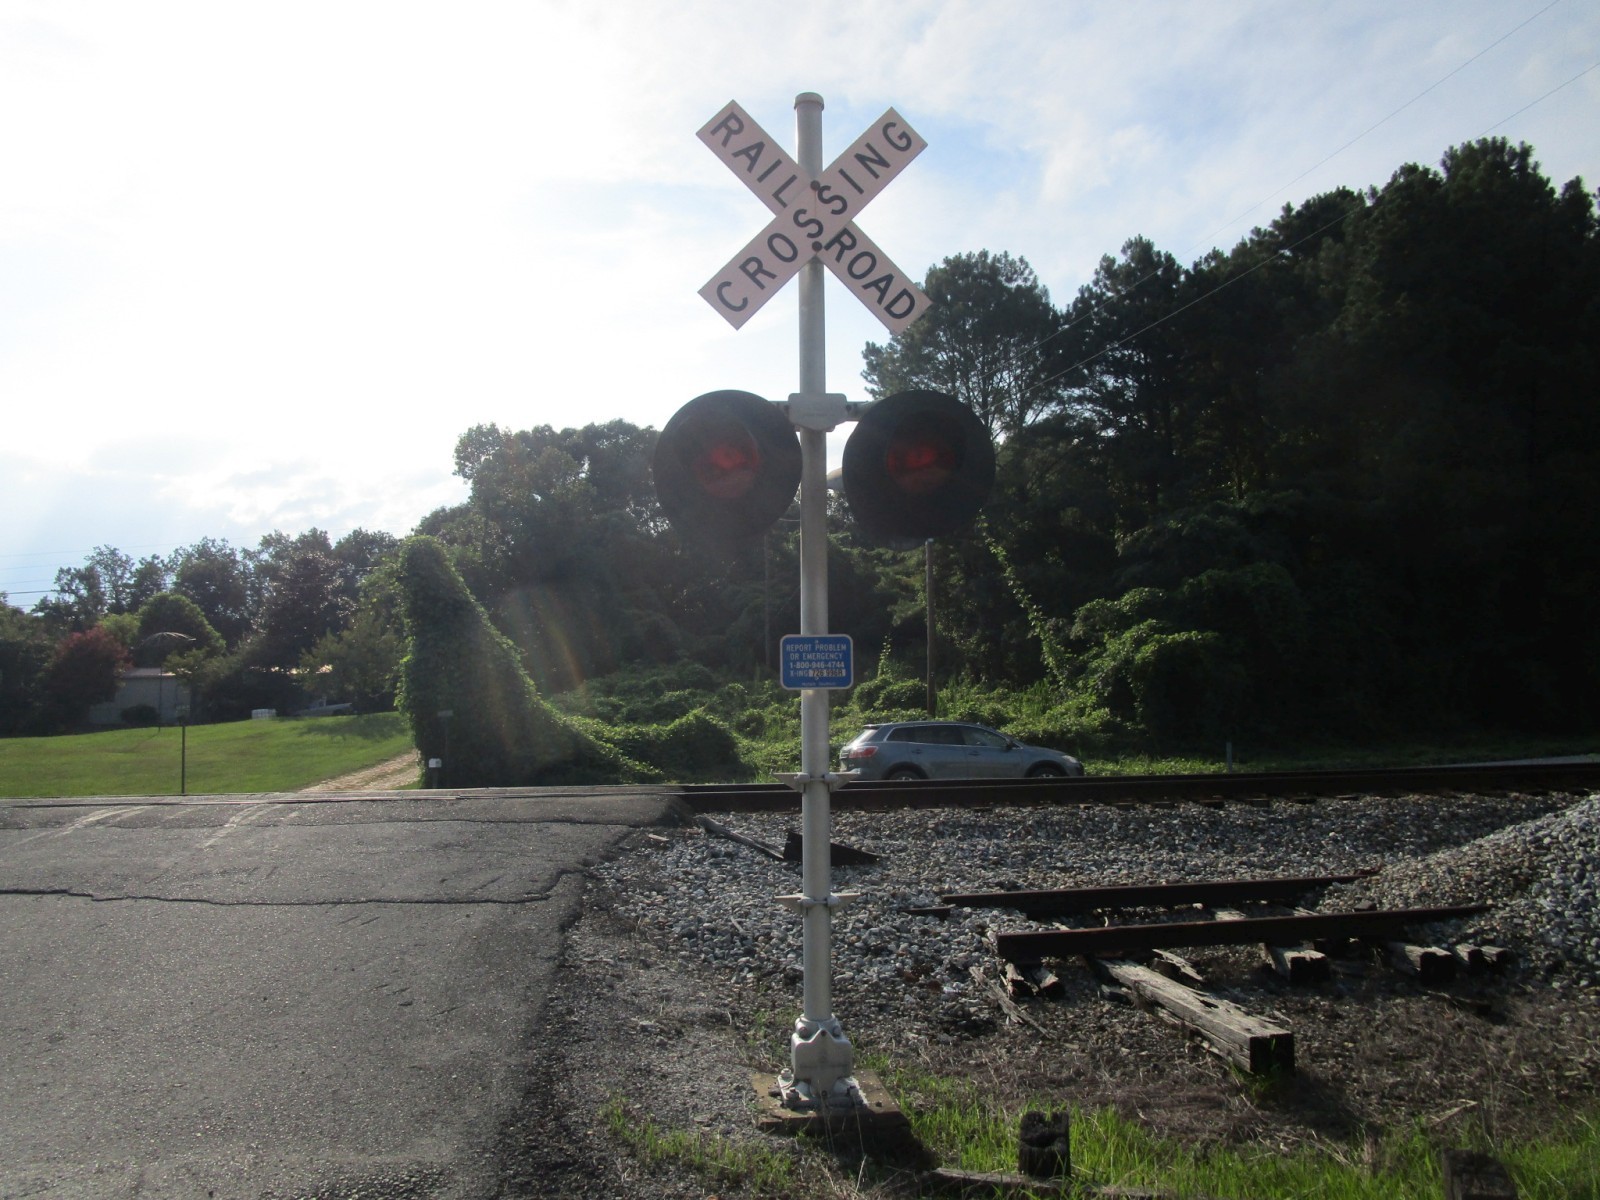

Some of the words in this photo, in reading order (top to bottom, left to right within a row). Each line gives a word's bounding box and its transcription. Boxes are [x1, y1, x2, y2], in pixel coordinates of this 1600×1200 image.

[710, 112, 798, 208] RAIL
[824, 228, 916, 319] ROAD
[716, 121, 912, 312] CROSSING
[786, 644, 811, 652] REPORT
[815, 644, 846, 652] PROBLEM
[790, 652, 800, 660] OR
[802, 652, 843, 660] EMERGENCY
